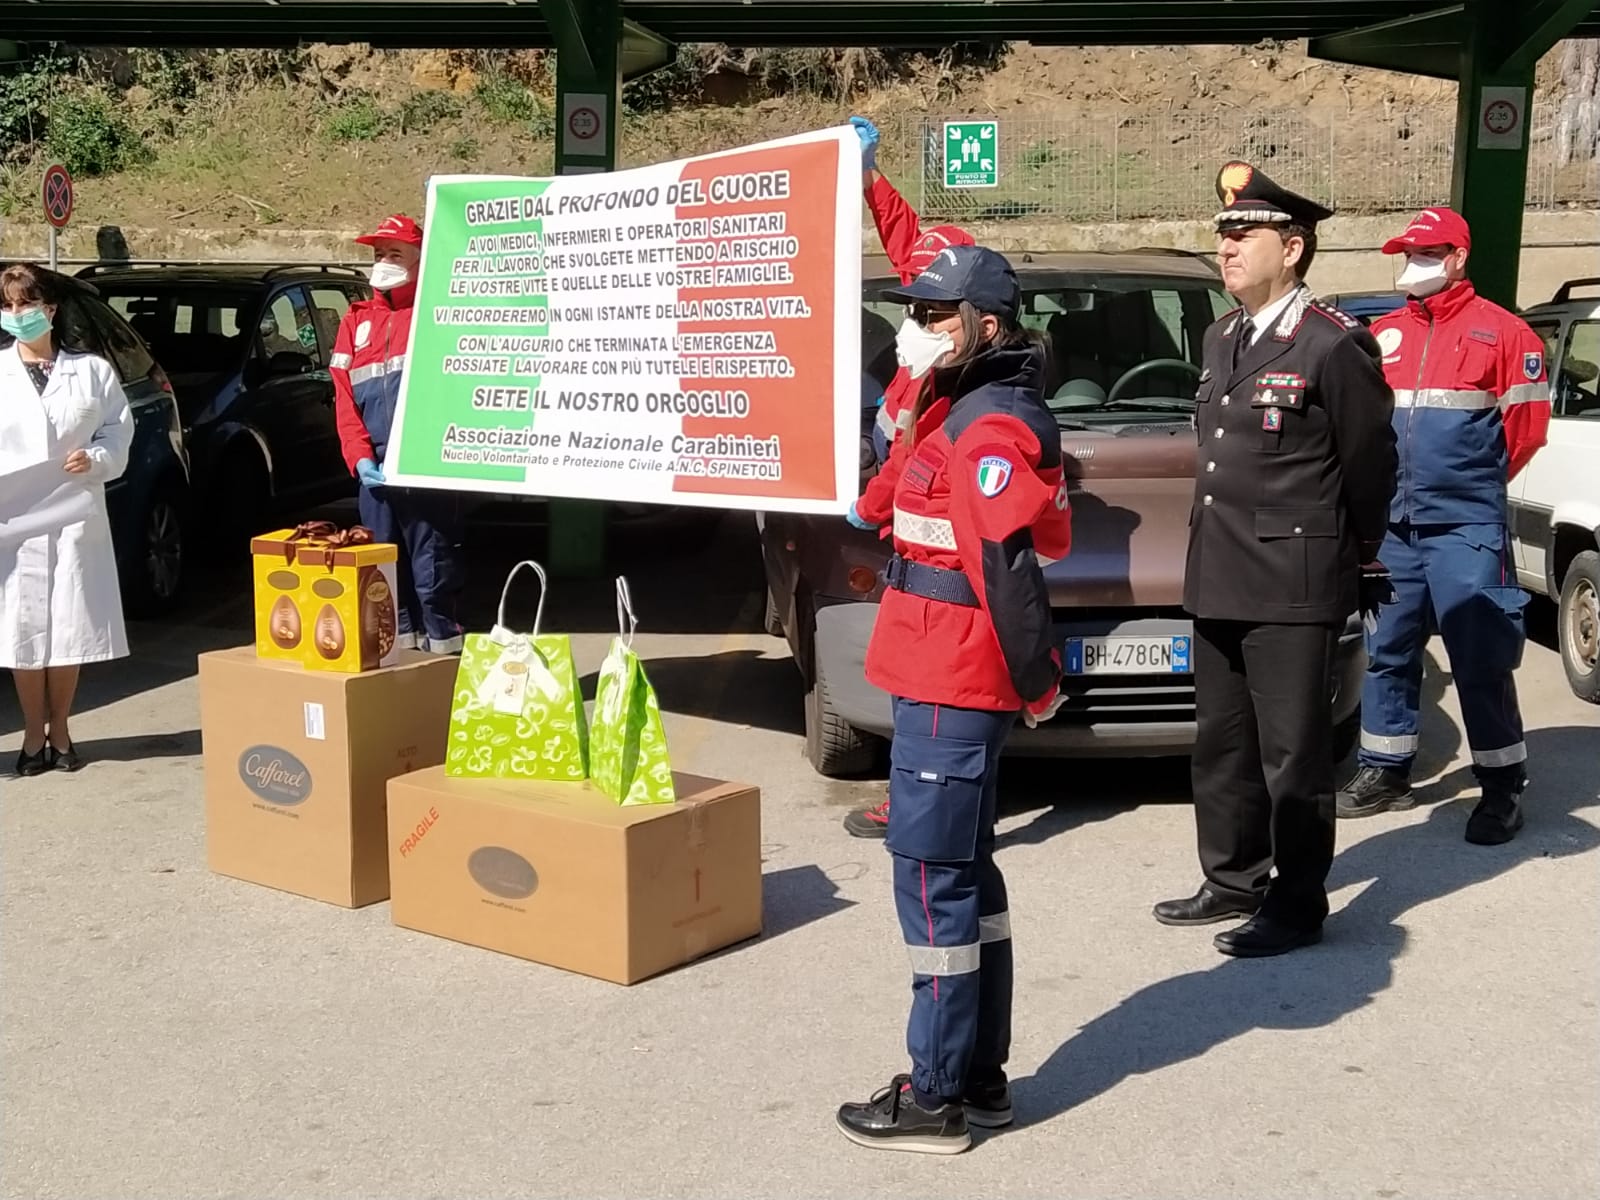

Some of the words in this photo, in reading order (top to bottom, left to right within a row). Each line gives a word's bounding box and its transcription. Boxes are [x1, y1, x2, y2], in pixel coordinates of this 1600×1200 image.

[466, 199, 519, 223] GRAZIE
[524, 197, 554, 218] DAL
[558, 186, 659, 214] PROFONDO
[666, 181, 705, 205] DEL
[711, 173, 788, 201] CUORE
[468, 238, 476, 253] A
[479, 237, 497, 252] VOI
[500, 235, 541, 252] MEDICI,
[544, 228, 611, 247] INFERMIERI
[616, 227, 623, 242] E
[627, 220, 707, 241] OPERATORI
[712, 214, 783, 236] SANITARI
[454, 260, 479, 273] PER
[483, 259, 494, 273] IL
[497, 256, 539, 272] LAVORO
[543, 254, 565, 270] CHE
[569, 250, 633, 267] SVOLGETE
[638, 244, 715, 264] METTENDO
[719, 244, 729, 260] A
[733, 239, 797, 258] RISCHIO
[450, 280, 467, 294] LE
[471, 279, 520, 294] VOSTRE
[524, 278, 548, 293] VITE
[552, 278, 559, 291] E
[561, 275, 607, 292] QUELLE
[611, 272, 651, 289] DELLE
[656, 269, 712, 286] VOSTRE
[717, 265, 792, 284] FAMIGLIE.
[435, 308, 448, 322] VI
[452, 308, 547, 323] RICORDEREMO
[549, 308, 562, 322] IN
[565, 307, 593, 322] OGNI
[597, 305, 651, 322] ISTANTE
[655, 302, 699, 319] DELLA
[703, 301, 764, 318] NOSTRA
[769, 299, 810, 316] VITA.
[459, 338, 487, 351] CON
[490, 338, 564, 353] L'AUGURIO
[568, 338, 592, 353] CHE
[594, 336, 668, 353] TERMINATA
[672, 334, 774, 351] L'EMERGENZA
[444, 358, 508, 373] POSSIATE
[515, 359, 588, 375] LAVORARE
[591, 361, 617, 375] CON
[621, 357, 642, 375] PIÙ
[645, 359, 697, 375] TUTELE
[702, 360, 710, 375] E
[715, 359, 793, 375] RISPETTO.
[473, 388, 528, 409] SIETE
[533, 390, 551, 409] IL
[557, 391, 639, 413] NOSTRO
[646, 392, 748, 415] ORGOGLIO
[444, 425, 561, 448] Associazione
[567, 431, 663, 453] Nazionale
[671, 435, 779, 457] Carabinieri
[442, 449, 479, 461] Nucleo
[482, 450, 549, 465] Volontariato
[552, 456, 559, 466] e
[562, 455, 625, 470] Protezione
[628, 458, 663, 472] Civile
[710, 462, 780, 478] SPINETOLI
[245, 753, 306, 788] Caffarel
[399, 806, 440, 858] FRAGILE
